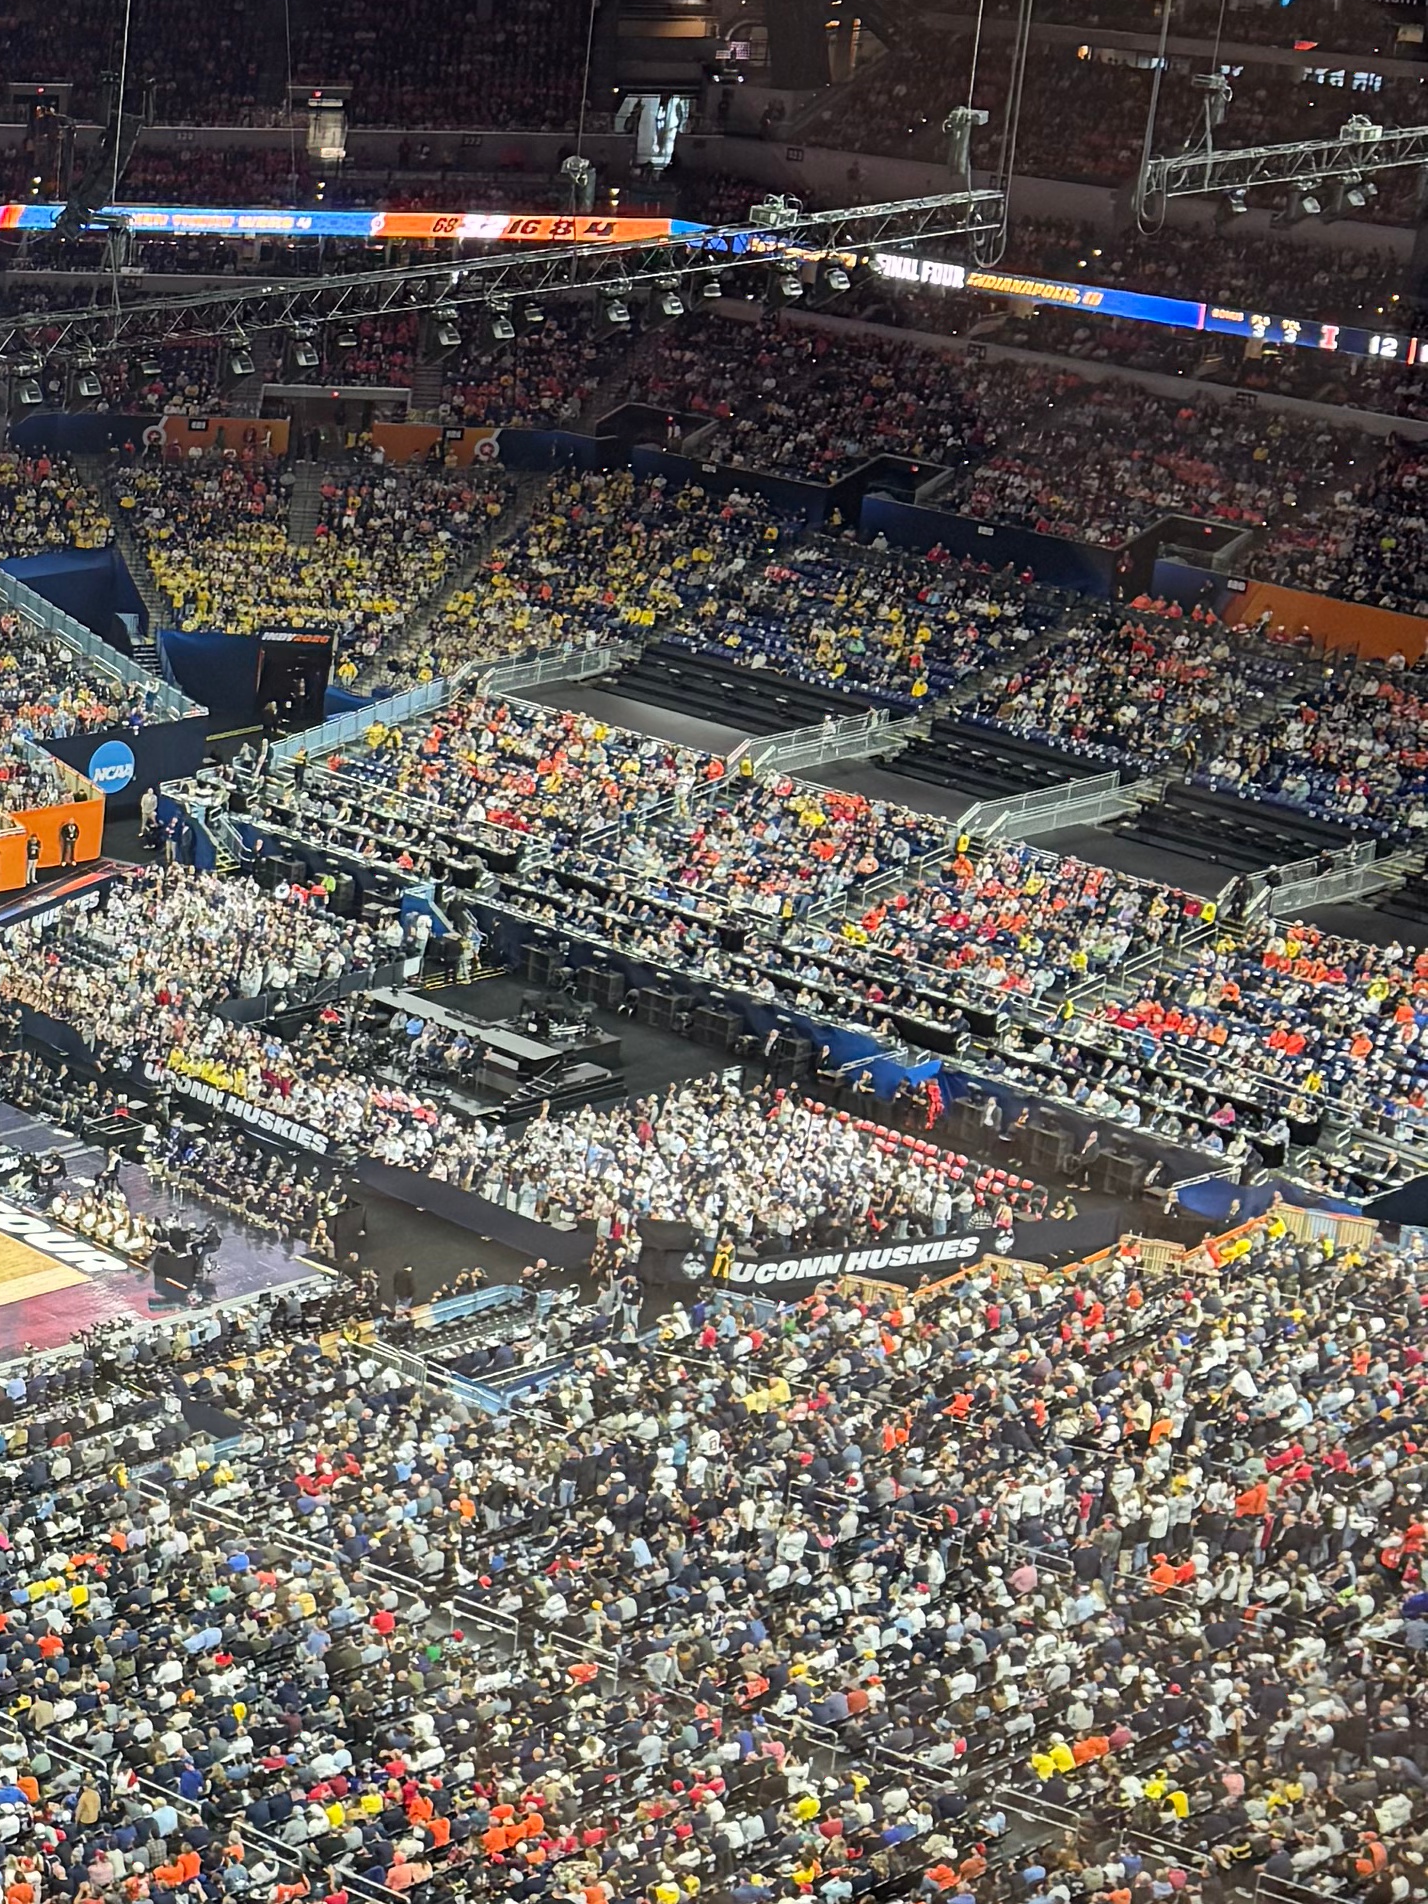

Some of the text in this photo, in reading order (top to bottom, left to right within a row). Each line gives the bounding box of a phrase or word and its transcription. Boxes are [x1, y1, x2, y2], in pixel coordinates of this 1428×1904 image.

[432, 217, 459, 233] 68
[507, 218, 541, 234] 16
[583, 221, 618, 236] 4
[921, 261, 965, 288] FOUR
[1368, 334, 1399, 358] 12
[93, 763, 135, 783] NCAA
[225, 1095, 330, 1156] HUSKIES
[729, 1236, 981, 1285] UCONN HUSKIES
